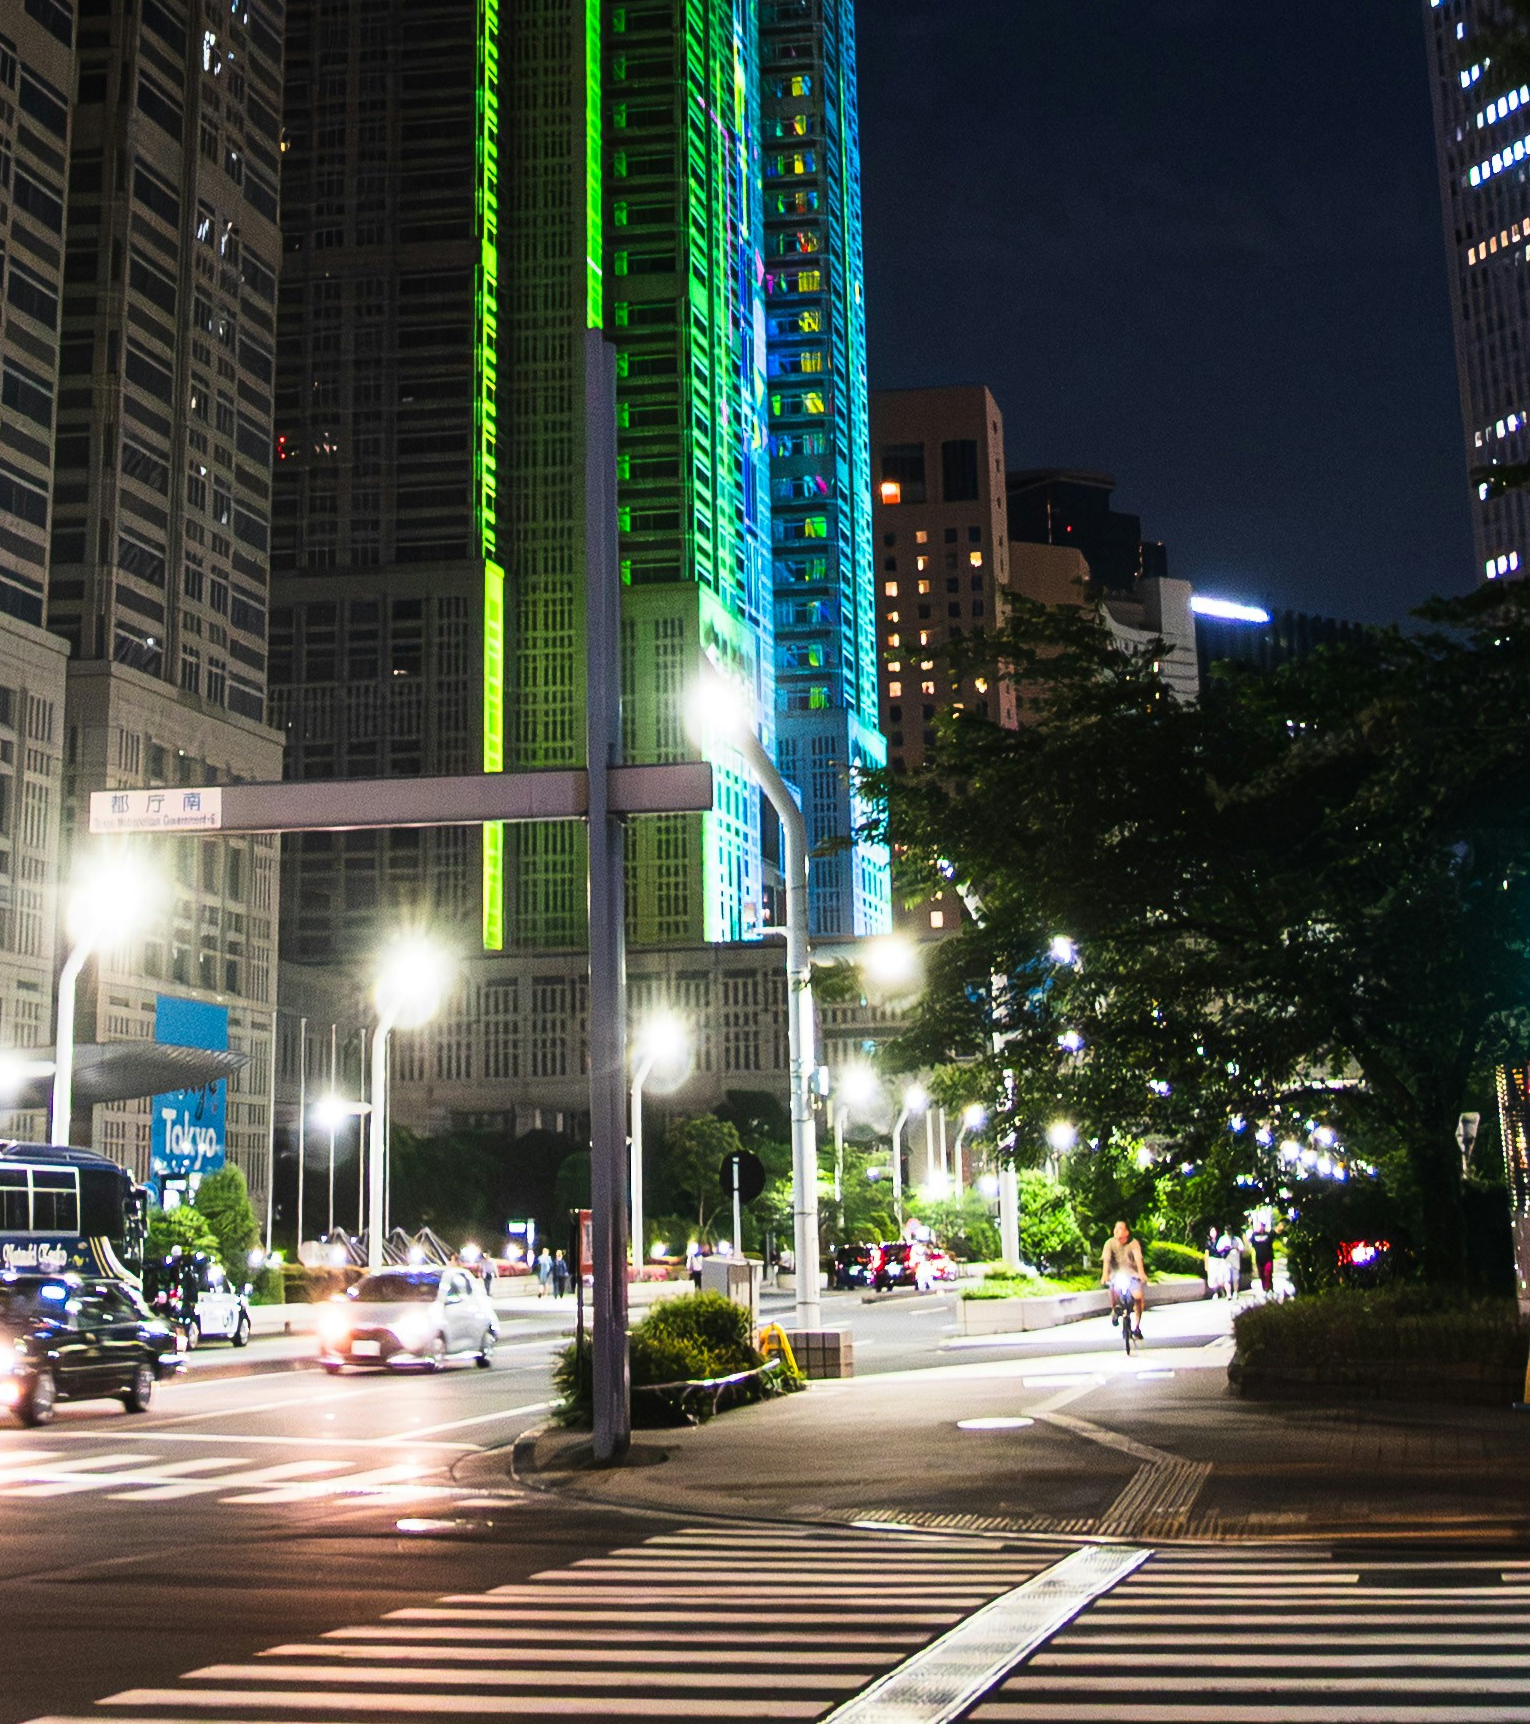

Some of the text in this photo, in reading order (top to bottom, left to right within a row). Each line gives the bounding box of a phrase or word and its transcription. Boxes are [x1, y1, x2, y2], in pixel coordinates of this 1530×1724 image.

[111, 792, 201, 814] 都庁南
[161, 1107, 217, 1171] Tokyo
